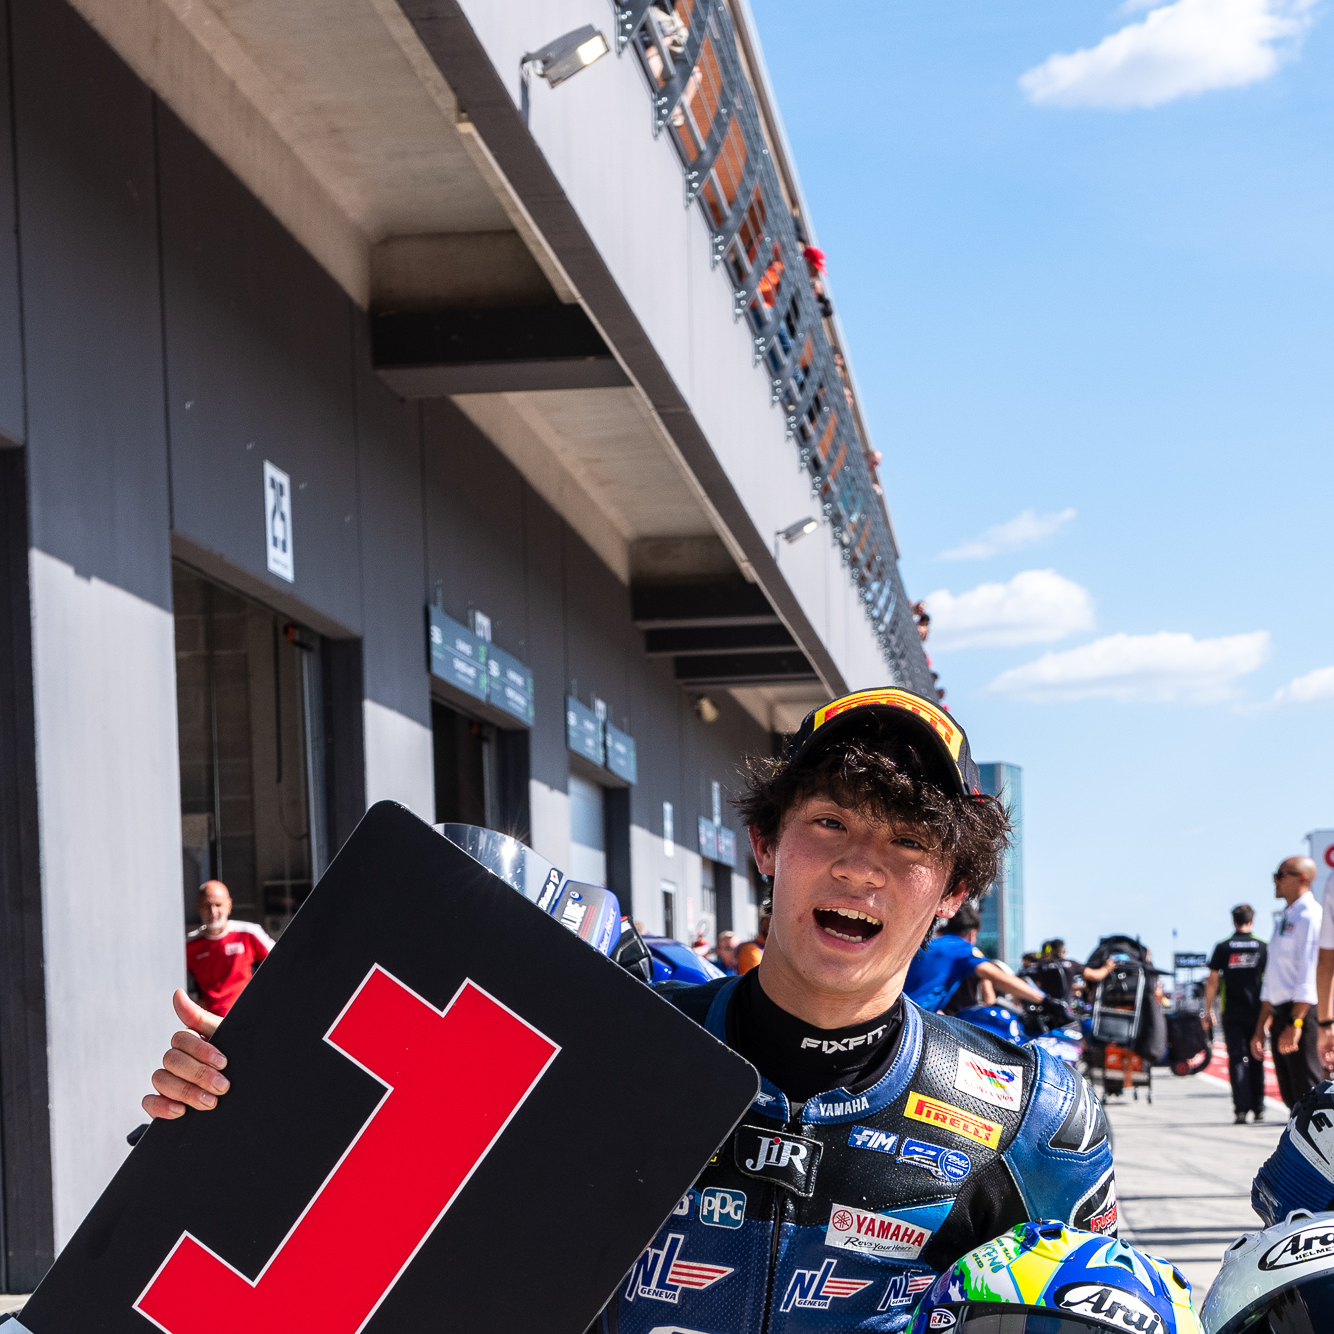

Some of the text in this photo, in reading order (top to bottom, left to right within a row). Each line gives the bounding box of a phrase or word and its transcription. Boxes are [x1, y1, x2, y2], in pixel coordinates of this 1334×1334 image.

[561, 899, 587, 934] ALUBE
[819, 1097, 870, 1116] YAMAHA
[915, 1099, 994, 1142] PIRELLI
[853, 1130, 897, 1150] FIM
[703, 1193, 743, 1222] PPG
[844, 1236, 874, 1249] Revs
[857, 1215, 927, 1247] YAMAHA
[625, 1233, 684, 1301] NL
[640, 1287, 678, 1301] GENEVA
[780, 1259, 837, 1312] NL
[877, 1270, 914, 1310] NL
[797, 1299, 828, 1309] GENEVA
[931, 1312, 952, 1325] R75
